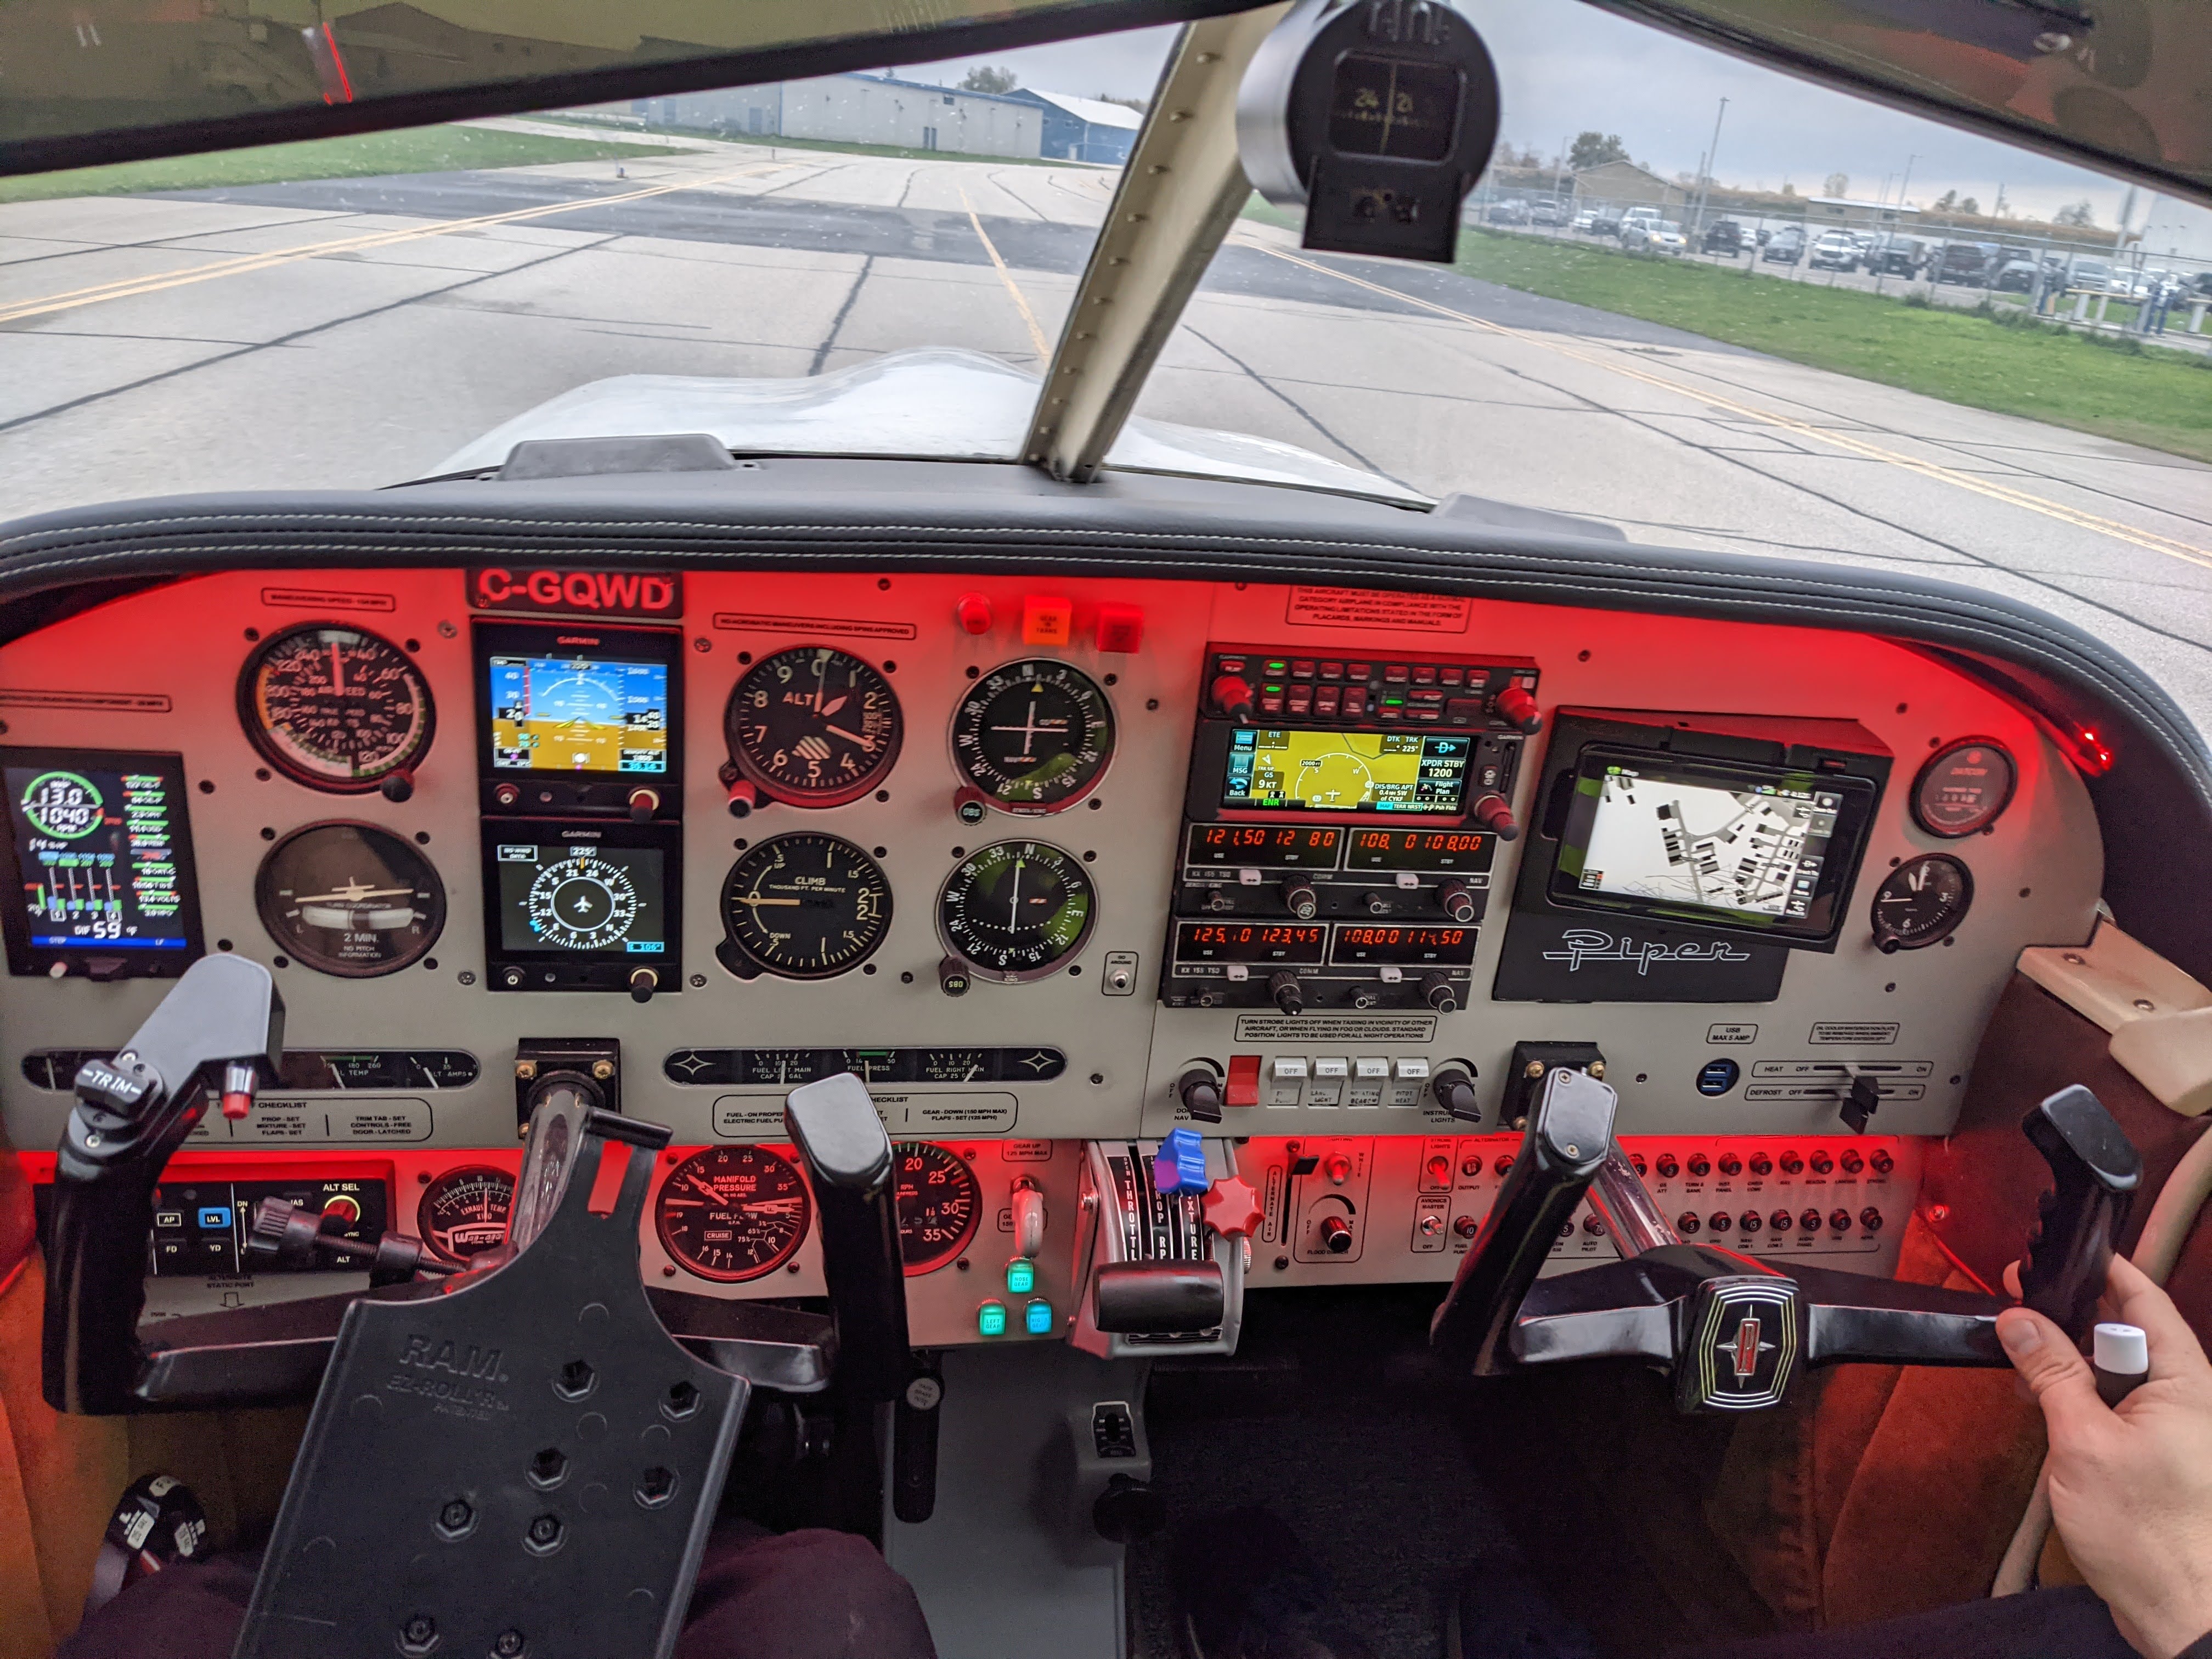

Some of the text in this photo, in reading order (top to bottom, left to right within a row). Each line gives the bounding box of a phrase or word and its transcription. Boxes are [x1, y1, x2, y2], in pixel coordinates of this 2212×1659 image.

[479, 568, 673, 610] C-GQWD
[776, 666, 793, 684] 9
[782, 692, 815, 707] ALT
[864, 692, 877, 709] 2
[840, 753, 856, 770] 4
[1421, 759, 1465, 768] XPDR STBY
[808, 761, 822, 778] 5
[1428, 768, 1453, 777] 1200
[40, 787, 83, 805] 13.0
[40, 808, 89, 825] 1040
[988, 846, 1005, 859] 33
[1024, 843, 1036, 855] N
[961, 862, 977, 877] 30
[794, 876, 826, 885] CLIMB
[857, 888, 870, 904] 2
[93, 921, 122, 939] 59
[343, 933, 352, 942] 2
[1543, 929, 1750, 975] Piper
[998, 954, 1008, 966] S
[713, 1175, 757, 1183] MANIFOLD
[342, 1183, 360, 1192] SEL
[460, 1204, 484, 1216] EXHAUS
[941, 1202, 959, 1215] 30
[923, 1229, 941, 1242] 35
